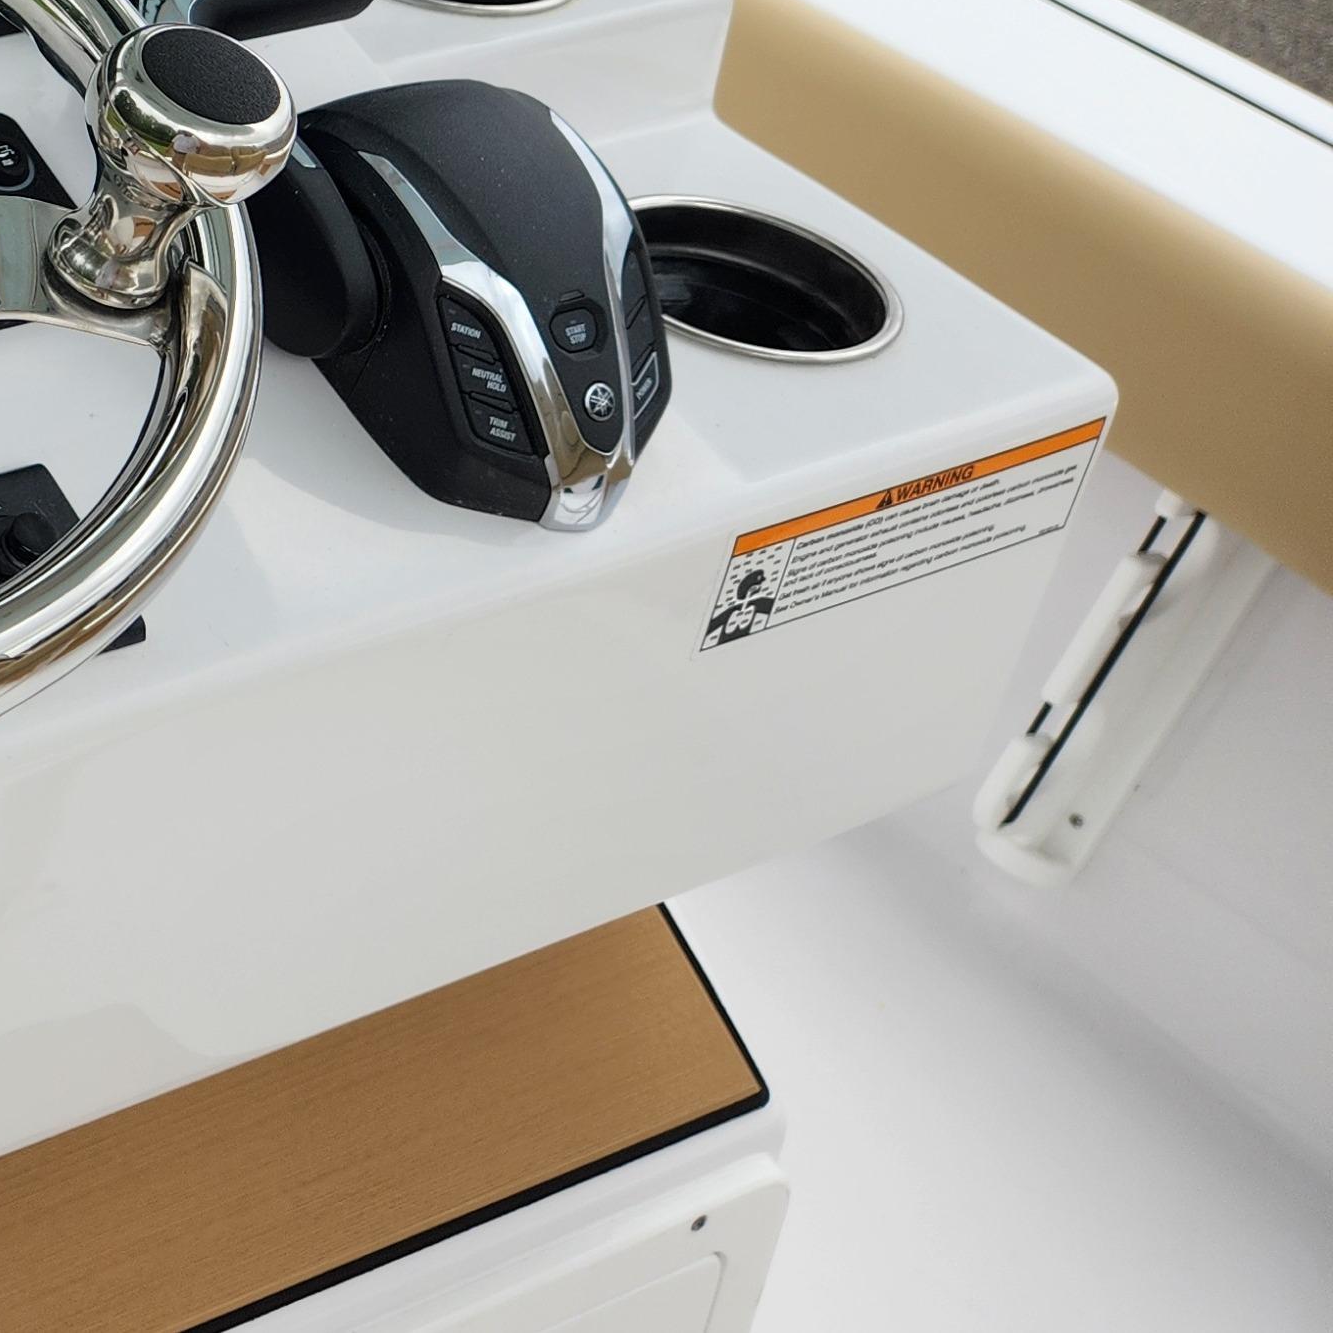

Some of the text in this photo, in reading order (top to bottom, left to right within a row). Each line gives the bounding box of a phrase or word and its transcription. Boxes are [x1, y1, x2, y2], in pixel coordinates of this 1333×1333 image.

[451, 322, 481, 339] STATION
[471, 367, 503, 383] NEUTRAL
[486, 380, 507, 393] HOLD
[489, 416, 509, 429] TRIM
[489, 427, 516, 442] ASSIST
[896, 464, 975, 502] WARNING
